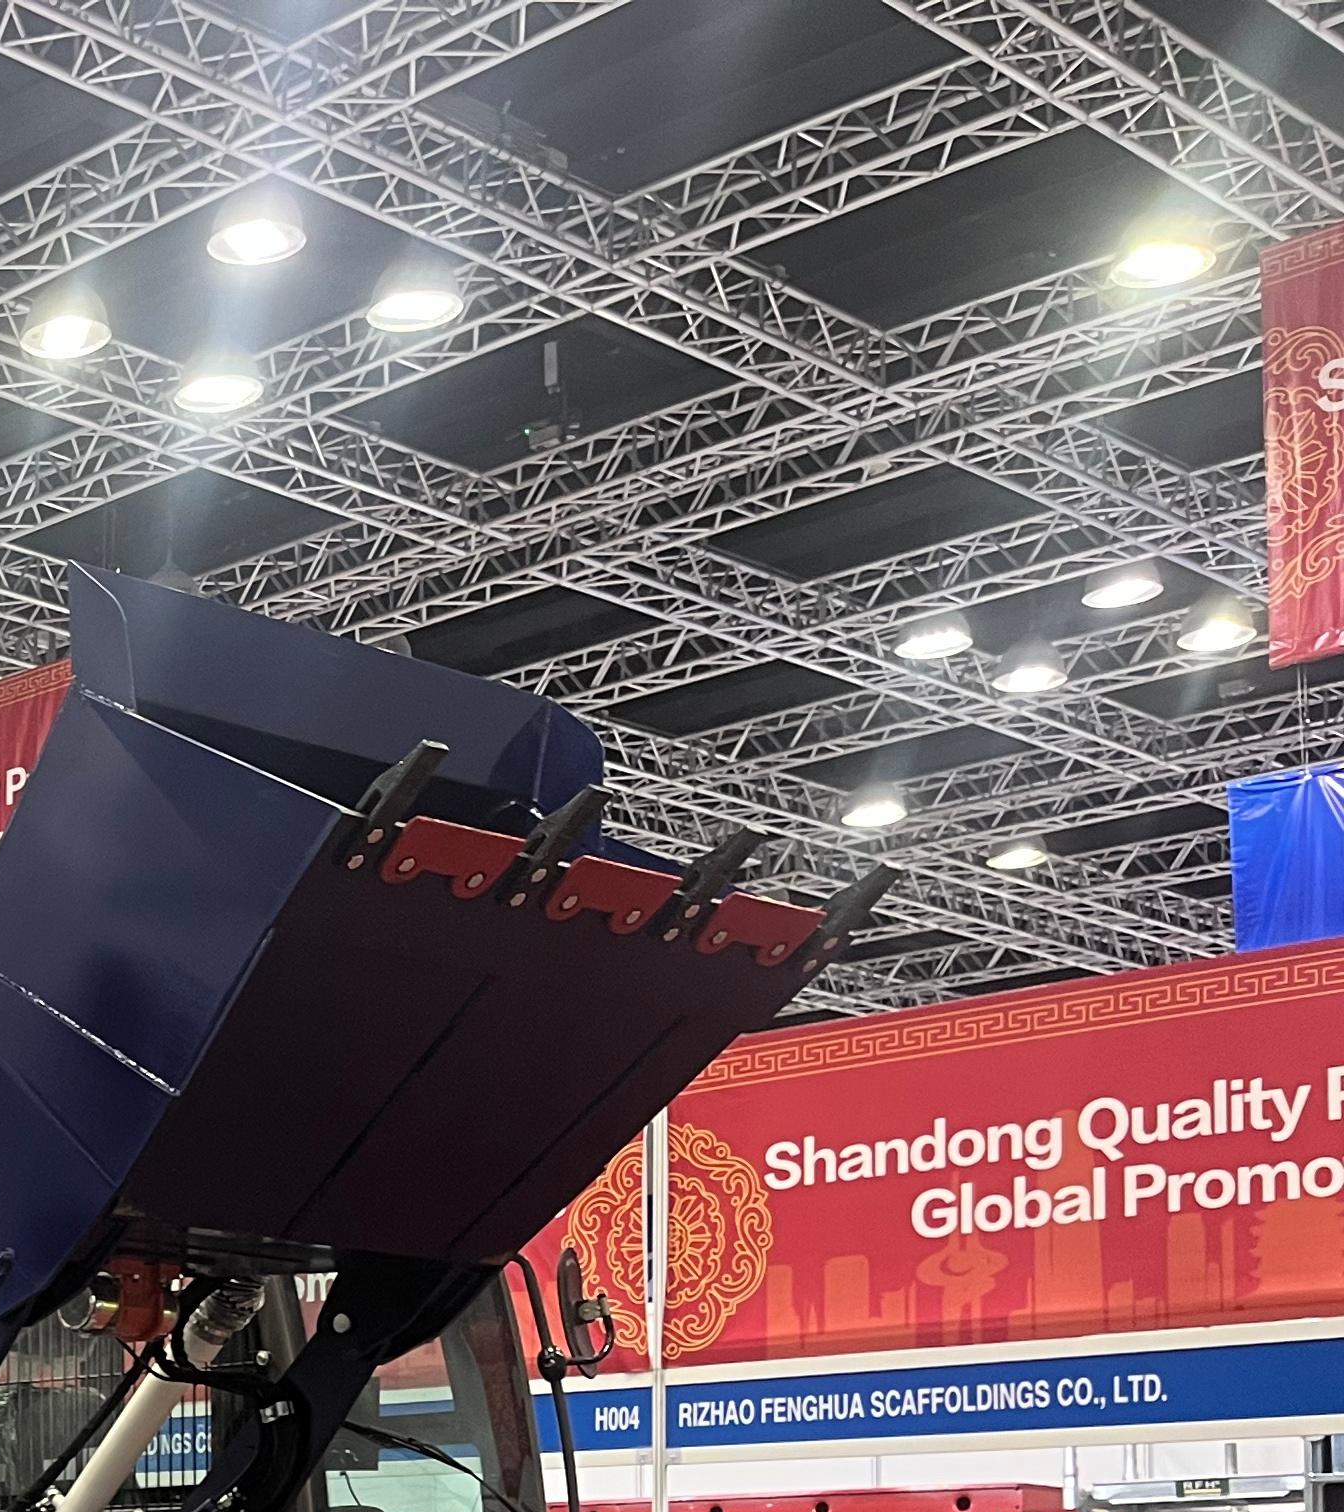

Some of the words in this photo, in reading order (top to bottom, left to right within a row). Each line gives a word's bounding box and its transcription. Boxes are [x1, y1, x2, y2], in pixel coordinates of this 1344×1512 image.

[763, 1117, 1064, 1191] Shandong
[1077, 1076, 1312, 1162] Quality
[910, 1167, 1106, 1239] Global
[1123, 1156, 1344, 1217] Promo
[595, 1405, 640, 1432] H004
[678, 1399, 755, 1428] RIZHAO
[761, 1394, 862, 1424] FENGHUA
[870, 1382, 1050, 1417] SCAFFOLDINGS
[1057, 1377, 1107, 1411] CO.,
[1113, 1373, 1168, 1403] LTD.
